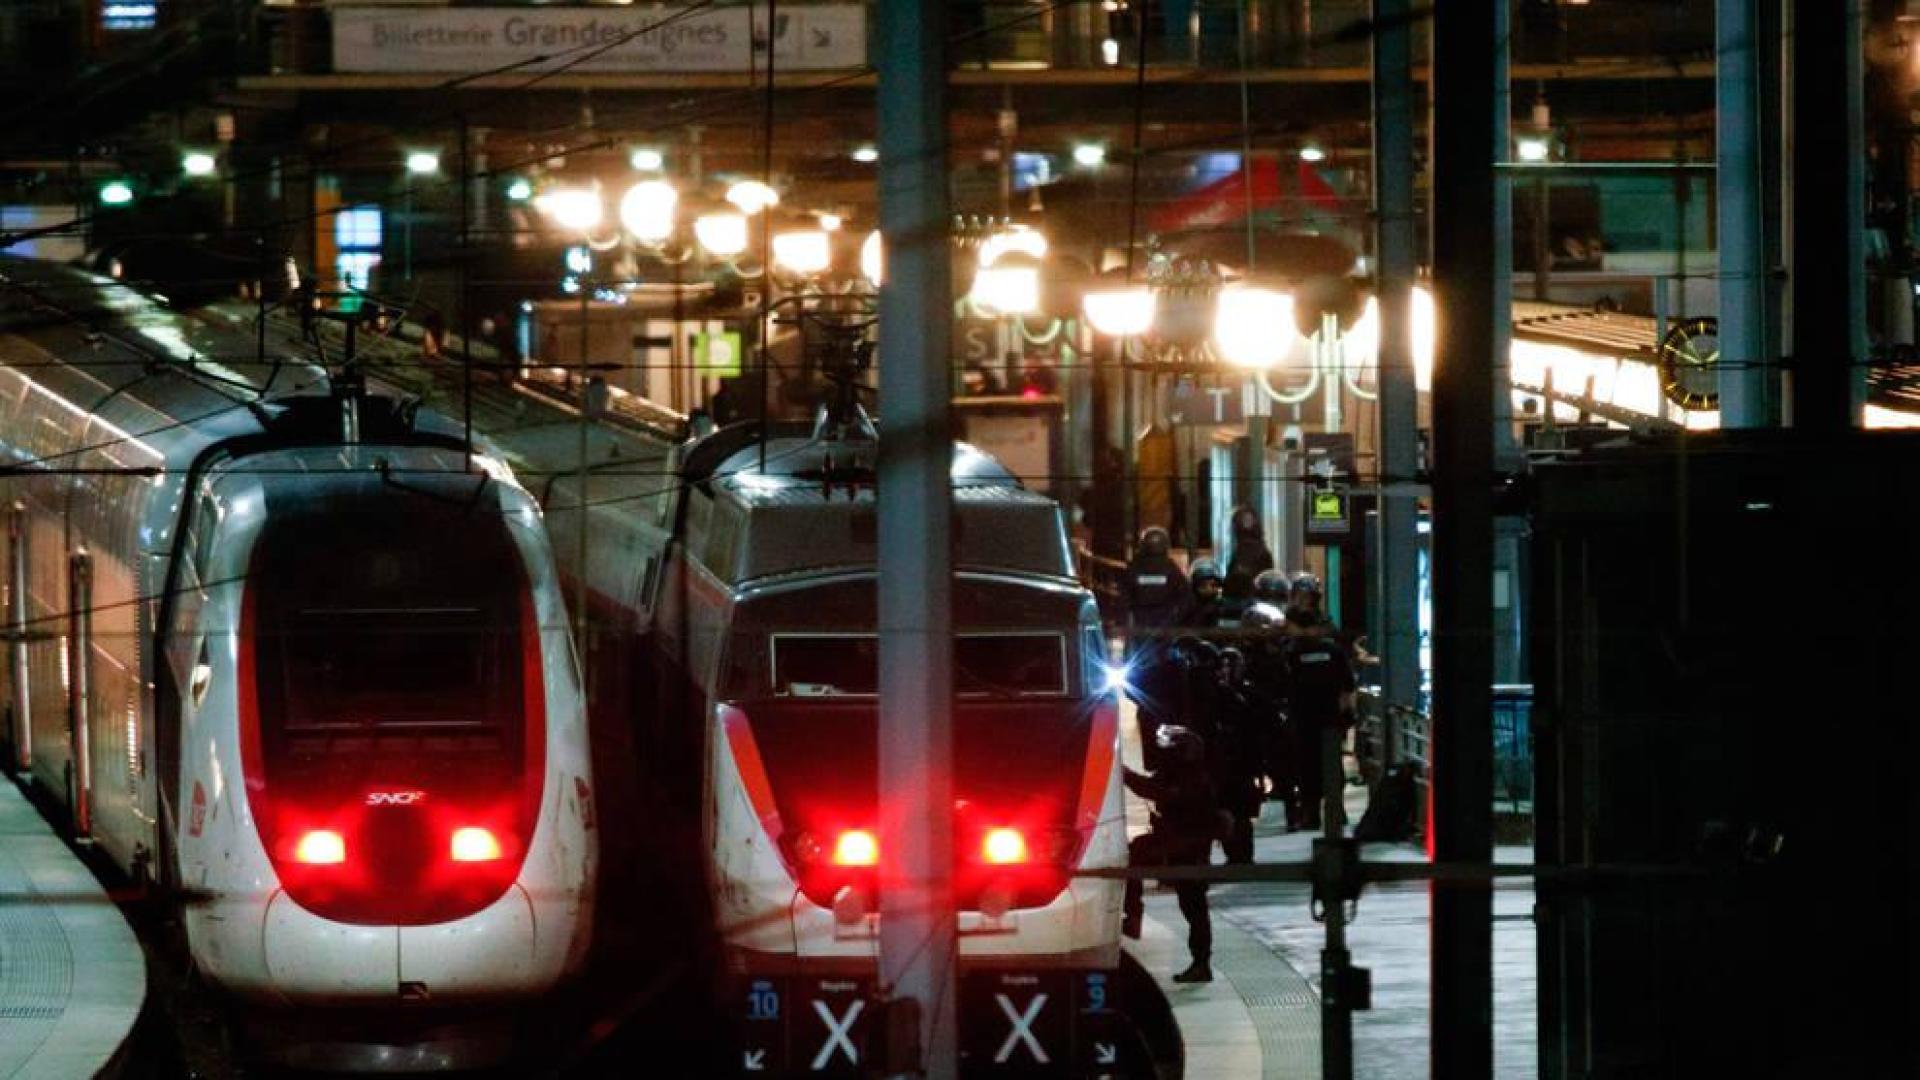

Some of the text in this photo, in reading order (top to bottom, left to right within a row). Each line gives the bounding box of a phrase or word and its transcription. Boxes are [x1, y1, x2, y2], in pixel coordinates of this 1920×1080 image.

[371, 15, 727, 52] Billetterie Grandes lignes
[365, 791, 425, 805] SNCF
[749, 991, 778, 1018] 10
[1088, 985, 1105, 1009] 9
[811, 999, 865, 1070] X
[994, 992, 1050, 1063] X
